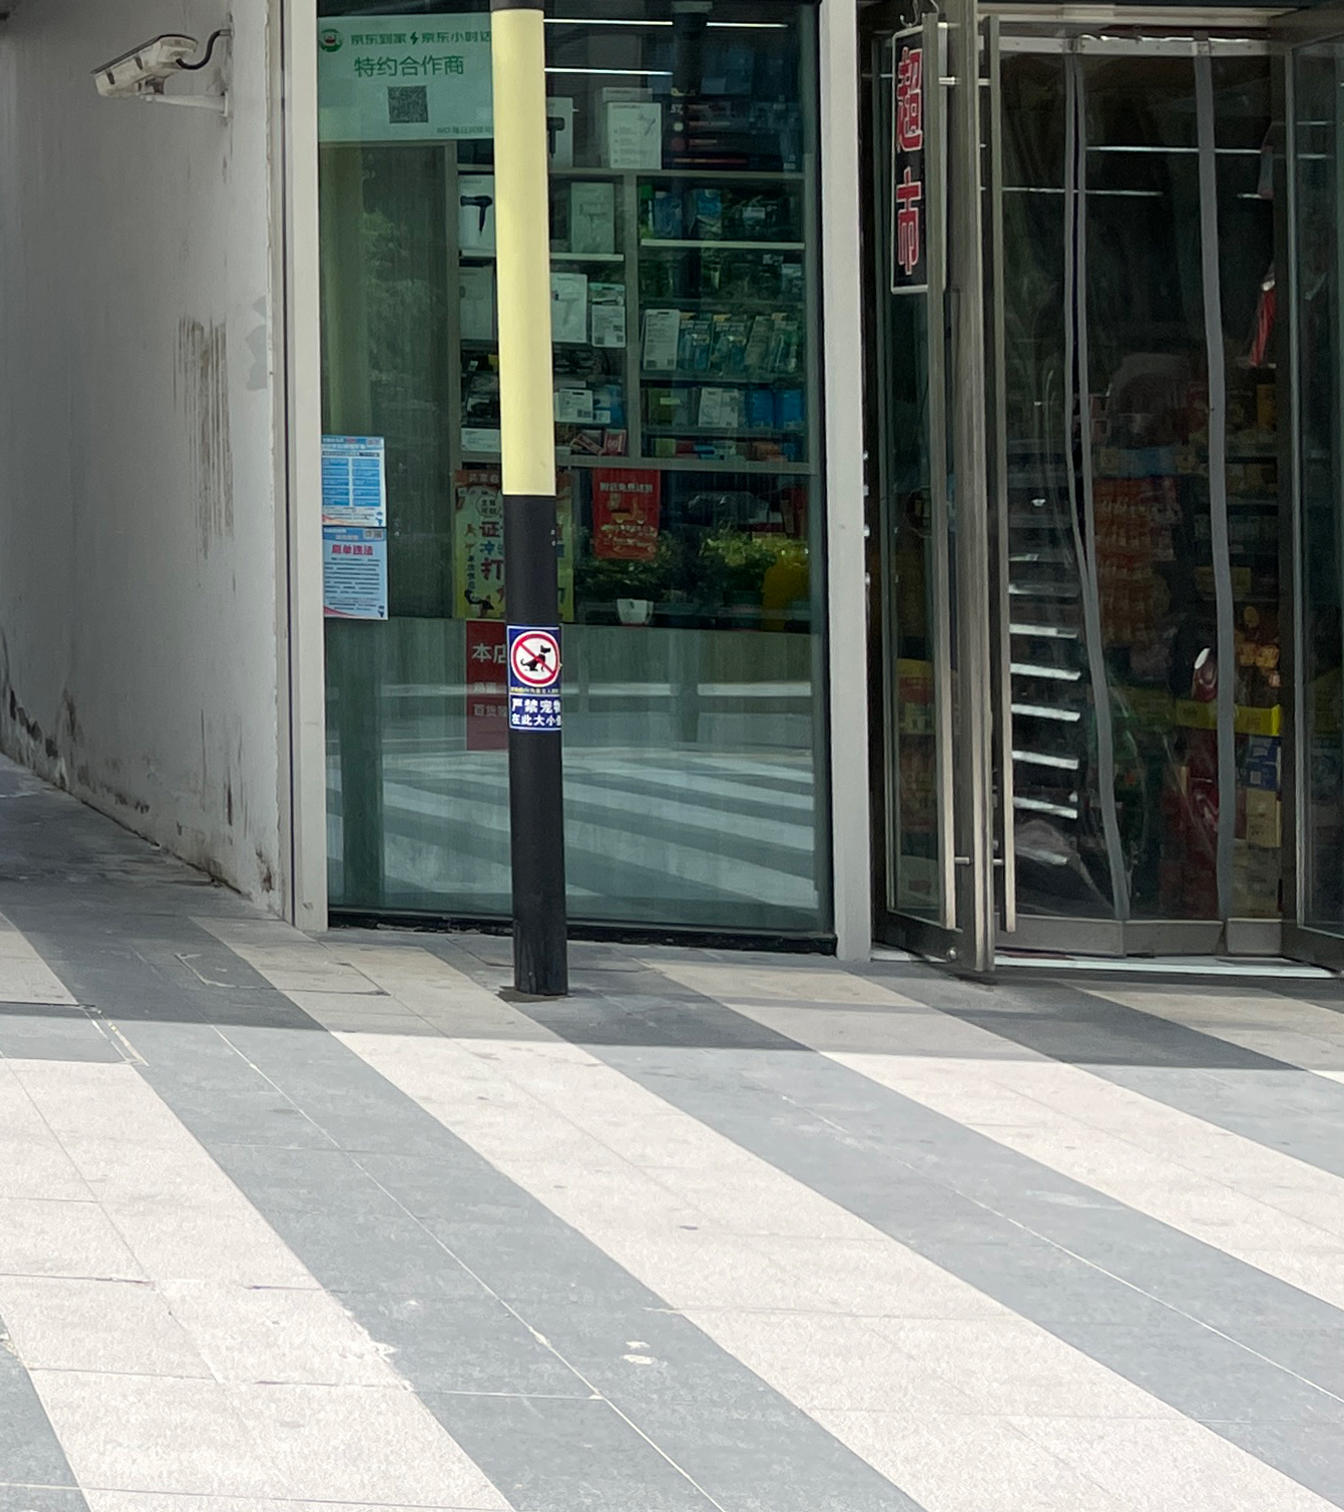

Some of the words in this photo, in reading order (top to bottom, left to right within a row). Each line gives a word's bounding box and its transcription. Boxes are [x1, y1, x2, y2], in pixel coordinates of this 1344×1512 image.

[354, 55, 465, 78] 特约合作商
[896, 46, 924, 276] 超市
